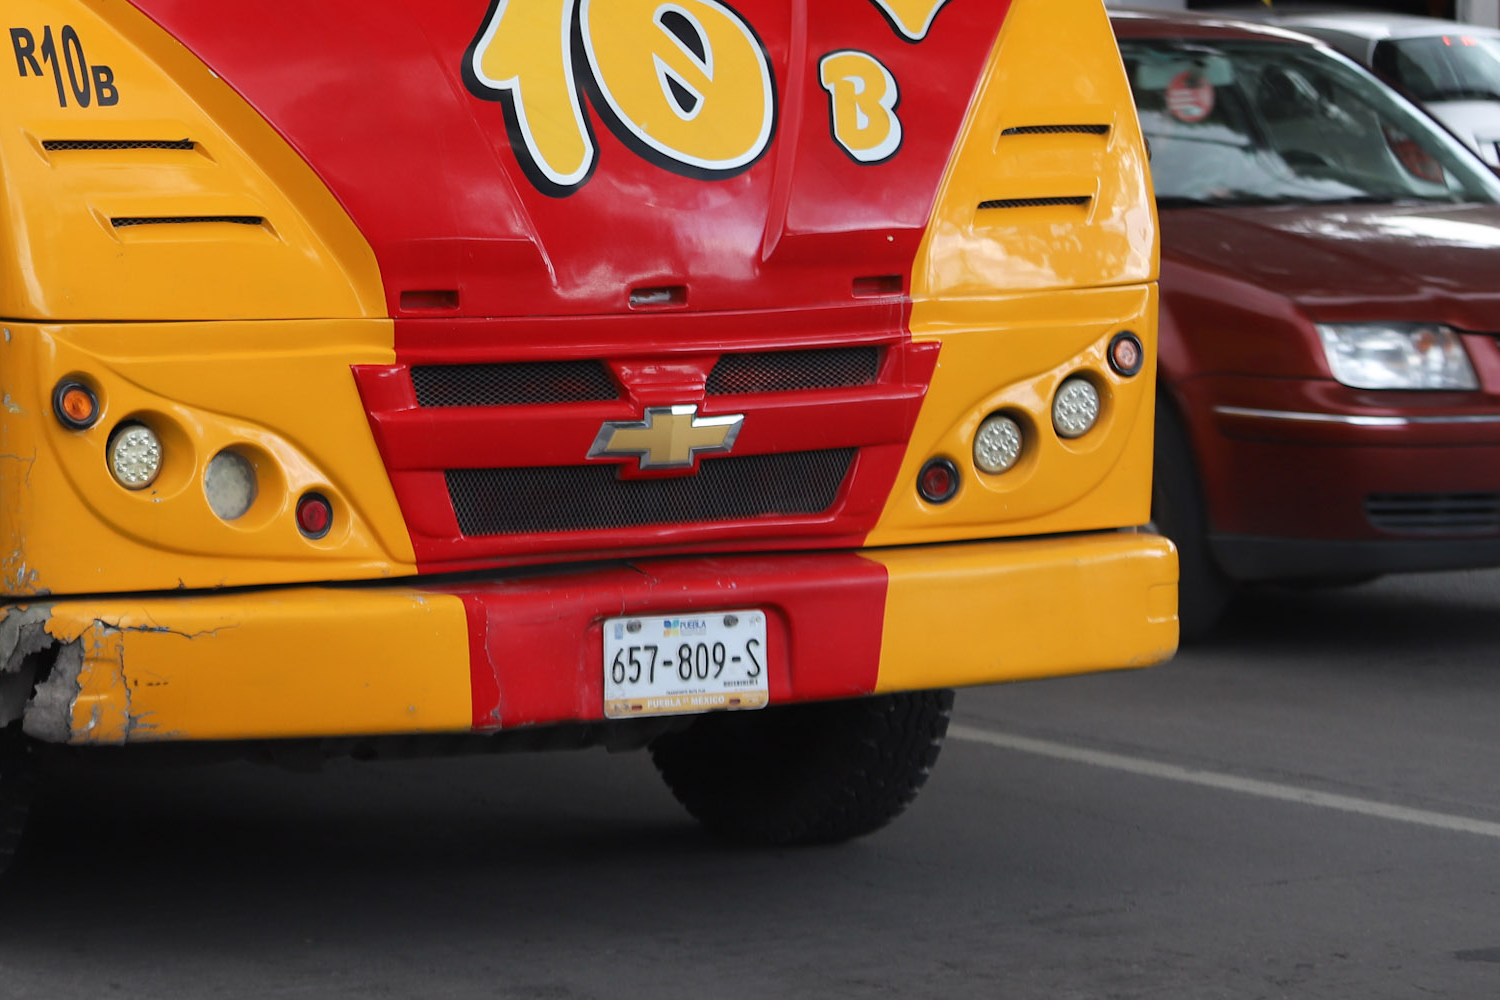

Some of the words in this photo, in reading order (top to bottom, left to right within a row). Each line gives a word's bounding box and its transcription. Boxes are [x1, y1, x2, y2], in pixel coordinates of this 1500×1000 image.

[817, 48, 903, 166] B
[612, 638, 762, 685] 657-809-S
[647, 696, 682, 709] PUEBLA
